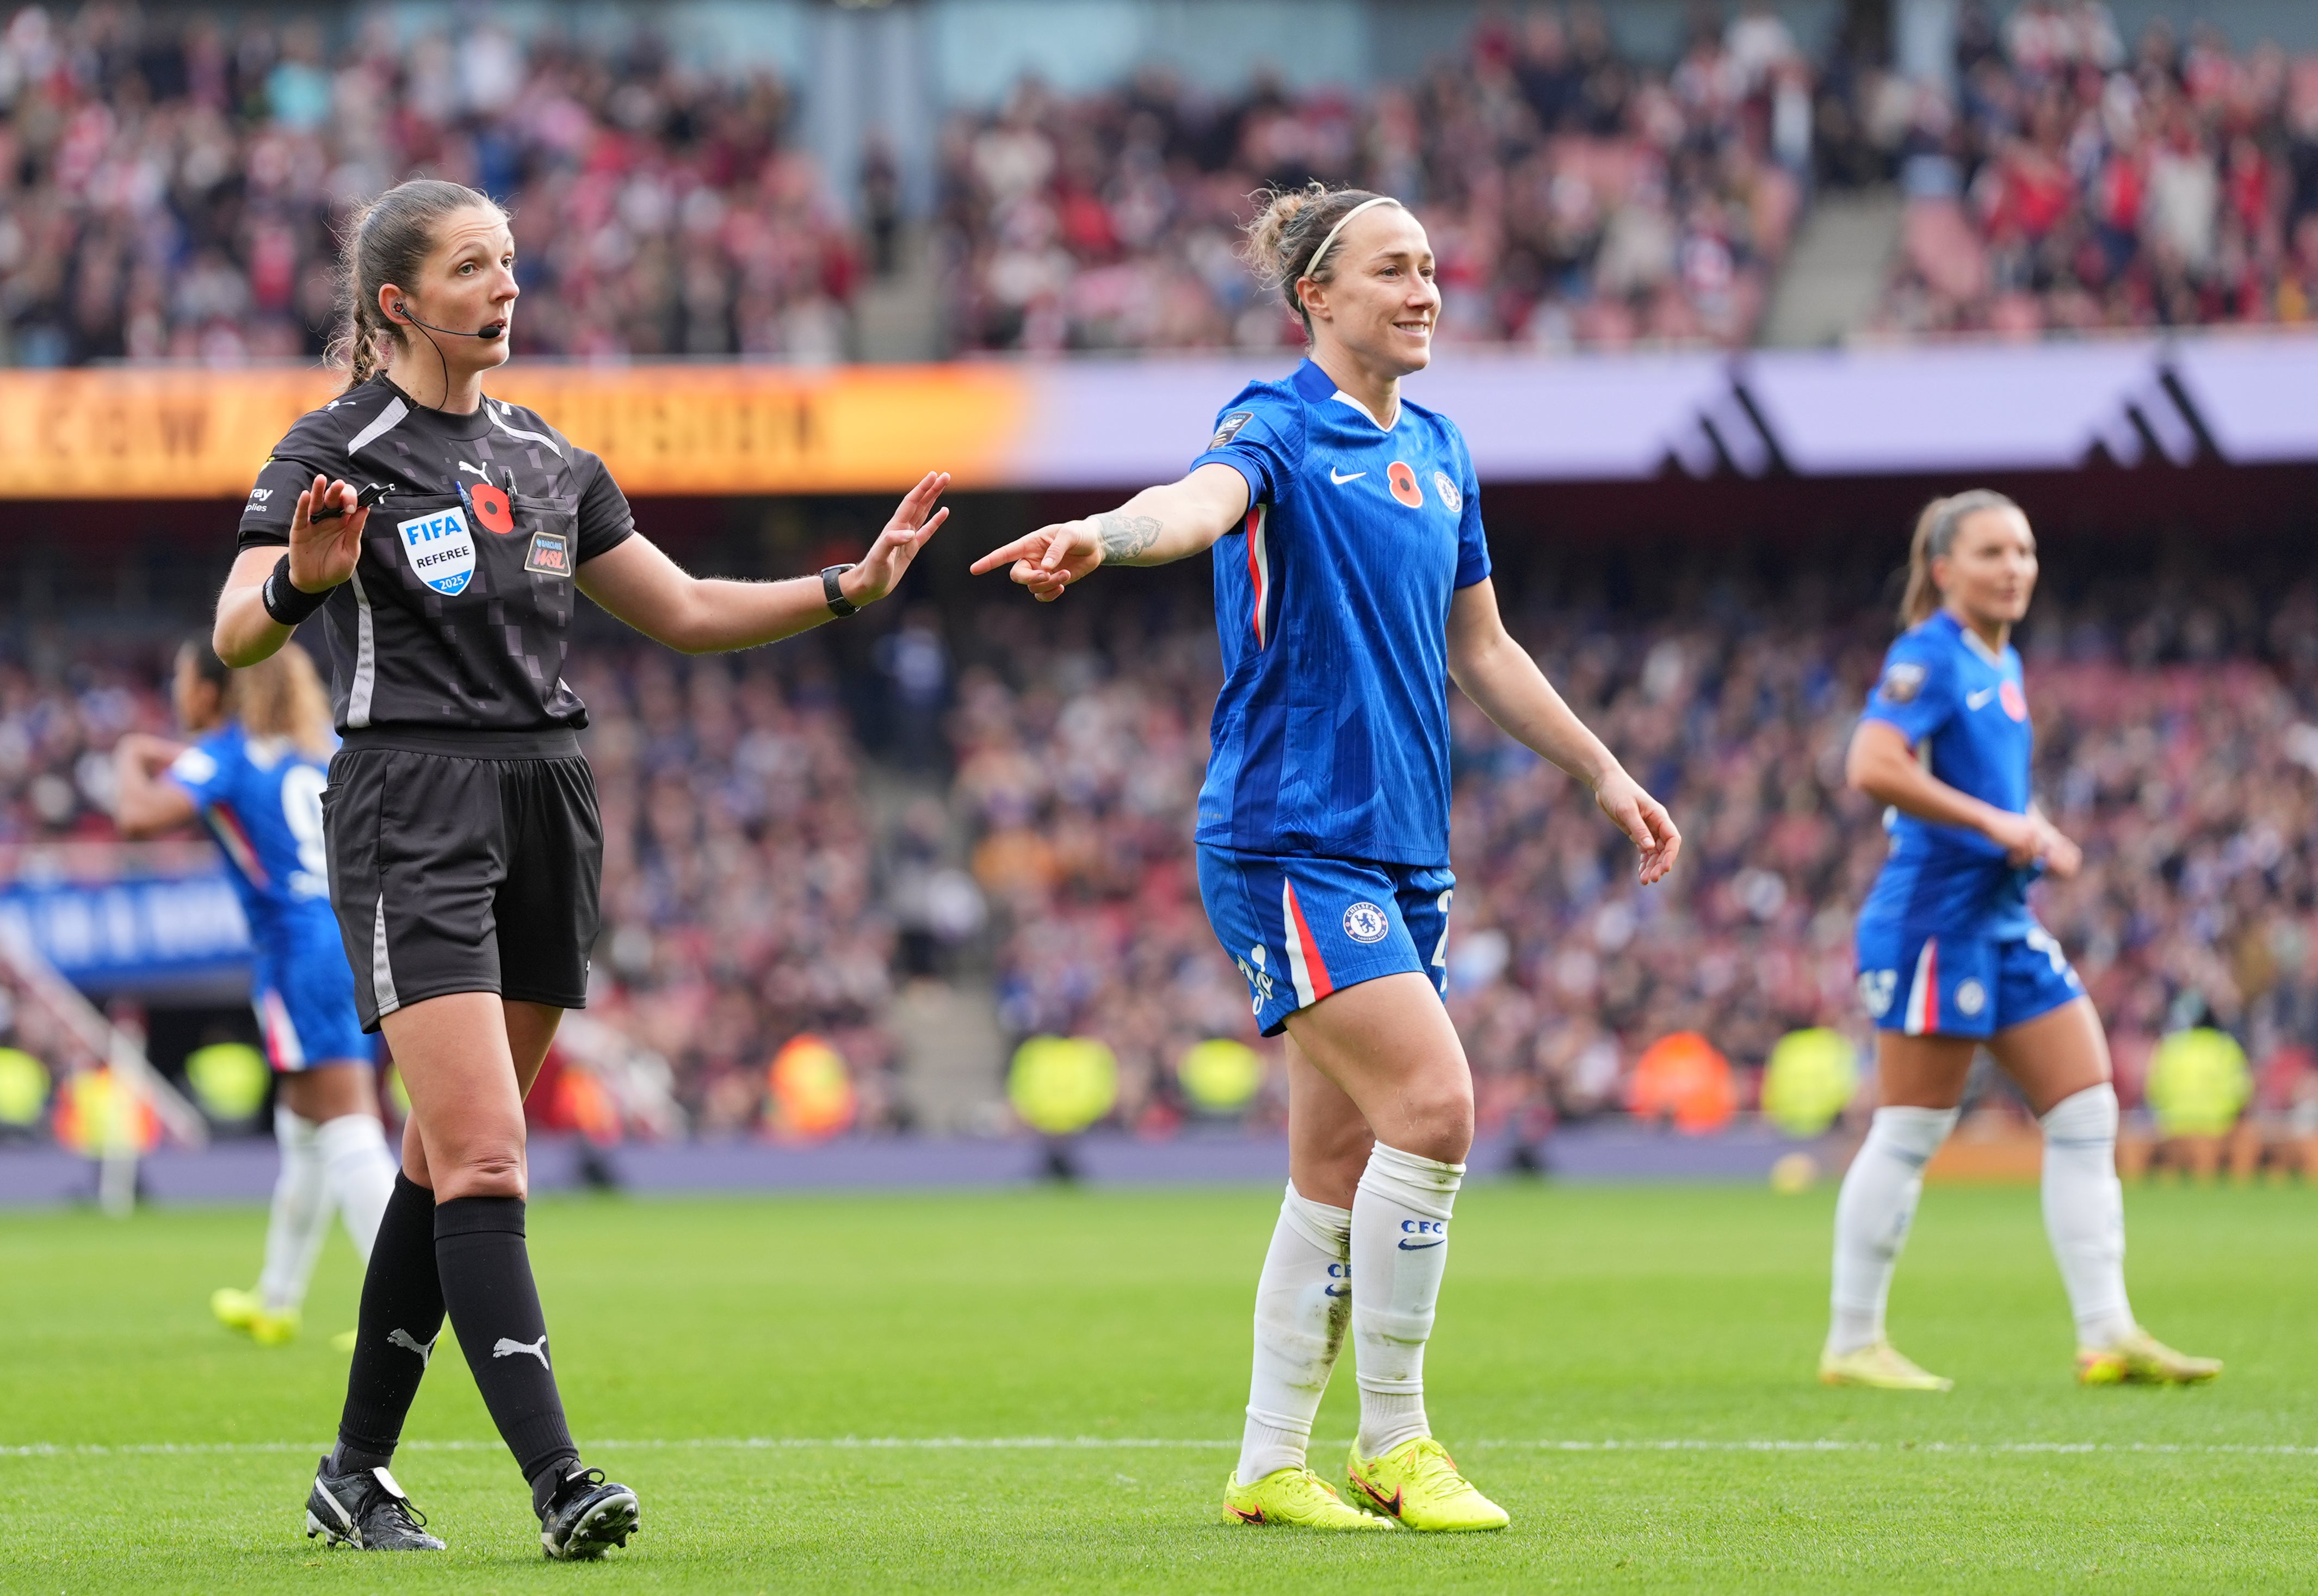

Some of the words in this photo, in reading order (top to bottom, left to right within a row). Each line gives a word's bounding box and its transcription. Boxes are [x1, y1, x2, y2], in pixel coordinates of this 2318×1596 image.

[406, 515, 462, 546] FIFA
[416, 546, 470, 568] REFEREE
[533, 548, 566, 570] WSL
[439, 575, 465, 590] 2025
[1346, 904, 1374, 918] CHELSEA
[1401, 1220, 1443, 1234] CFC
